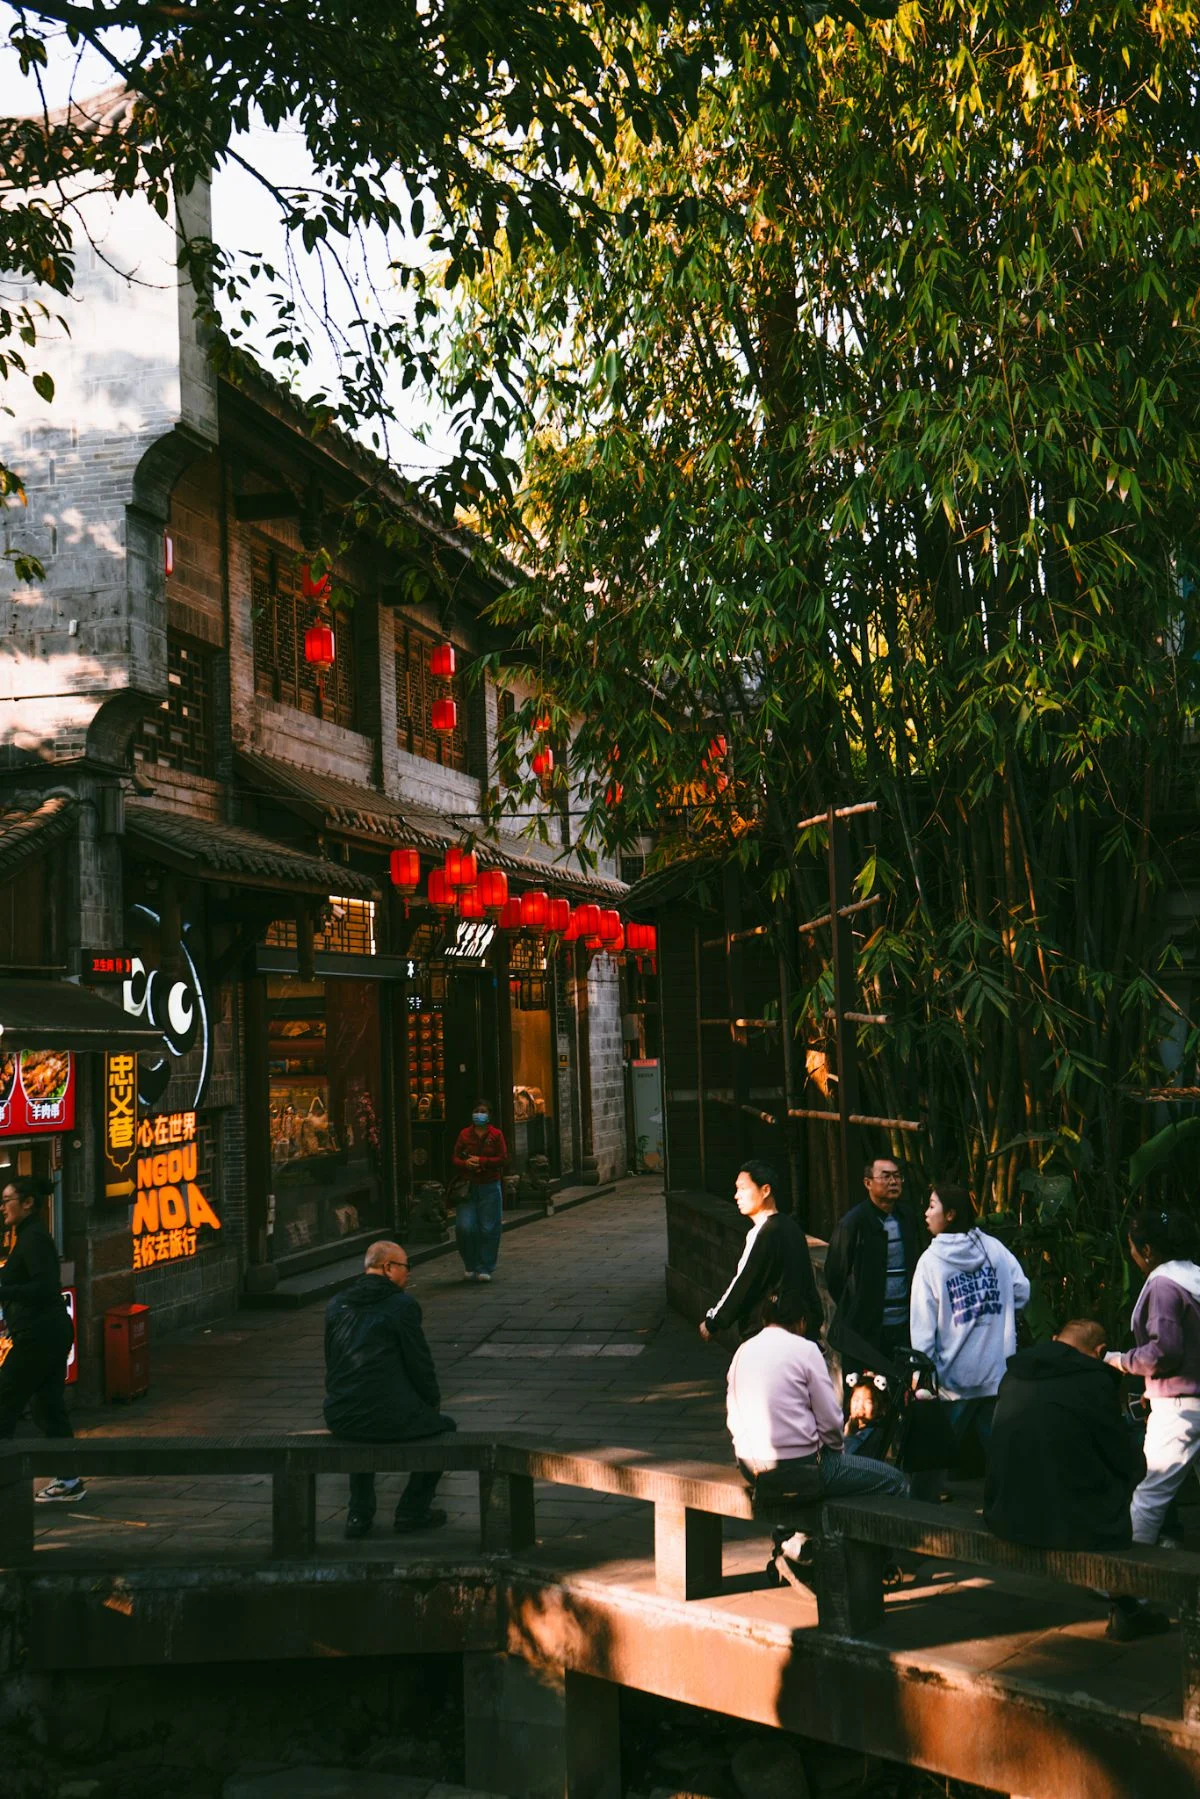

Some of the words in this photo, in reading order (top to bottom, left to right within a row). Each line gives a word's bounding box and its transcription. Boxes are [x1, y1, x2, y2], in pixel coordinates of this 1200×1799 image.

[32, 1103, 60, 1120] 羊肉串
[109, 1055, 134, 1148] 忠义巷
[137, 1142, 198, 1190] NGOU
[132, 1182, 222, 1236] NOA
[948, 1278, 999, 1302] MISSLAZY
